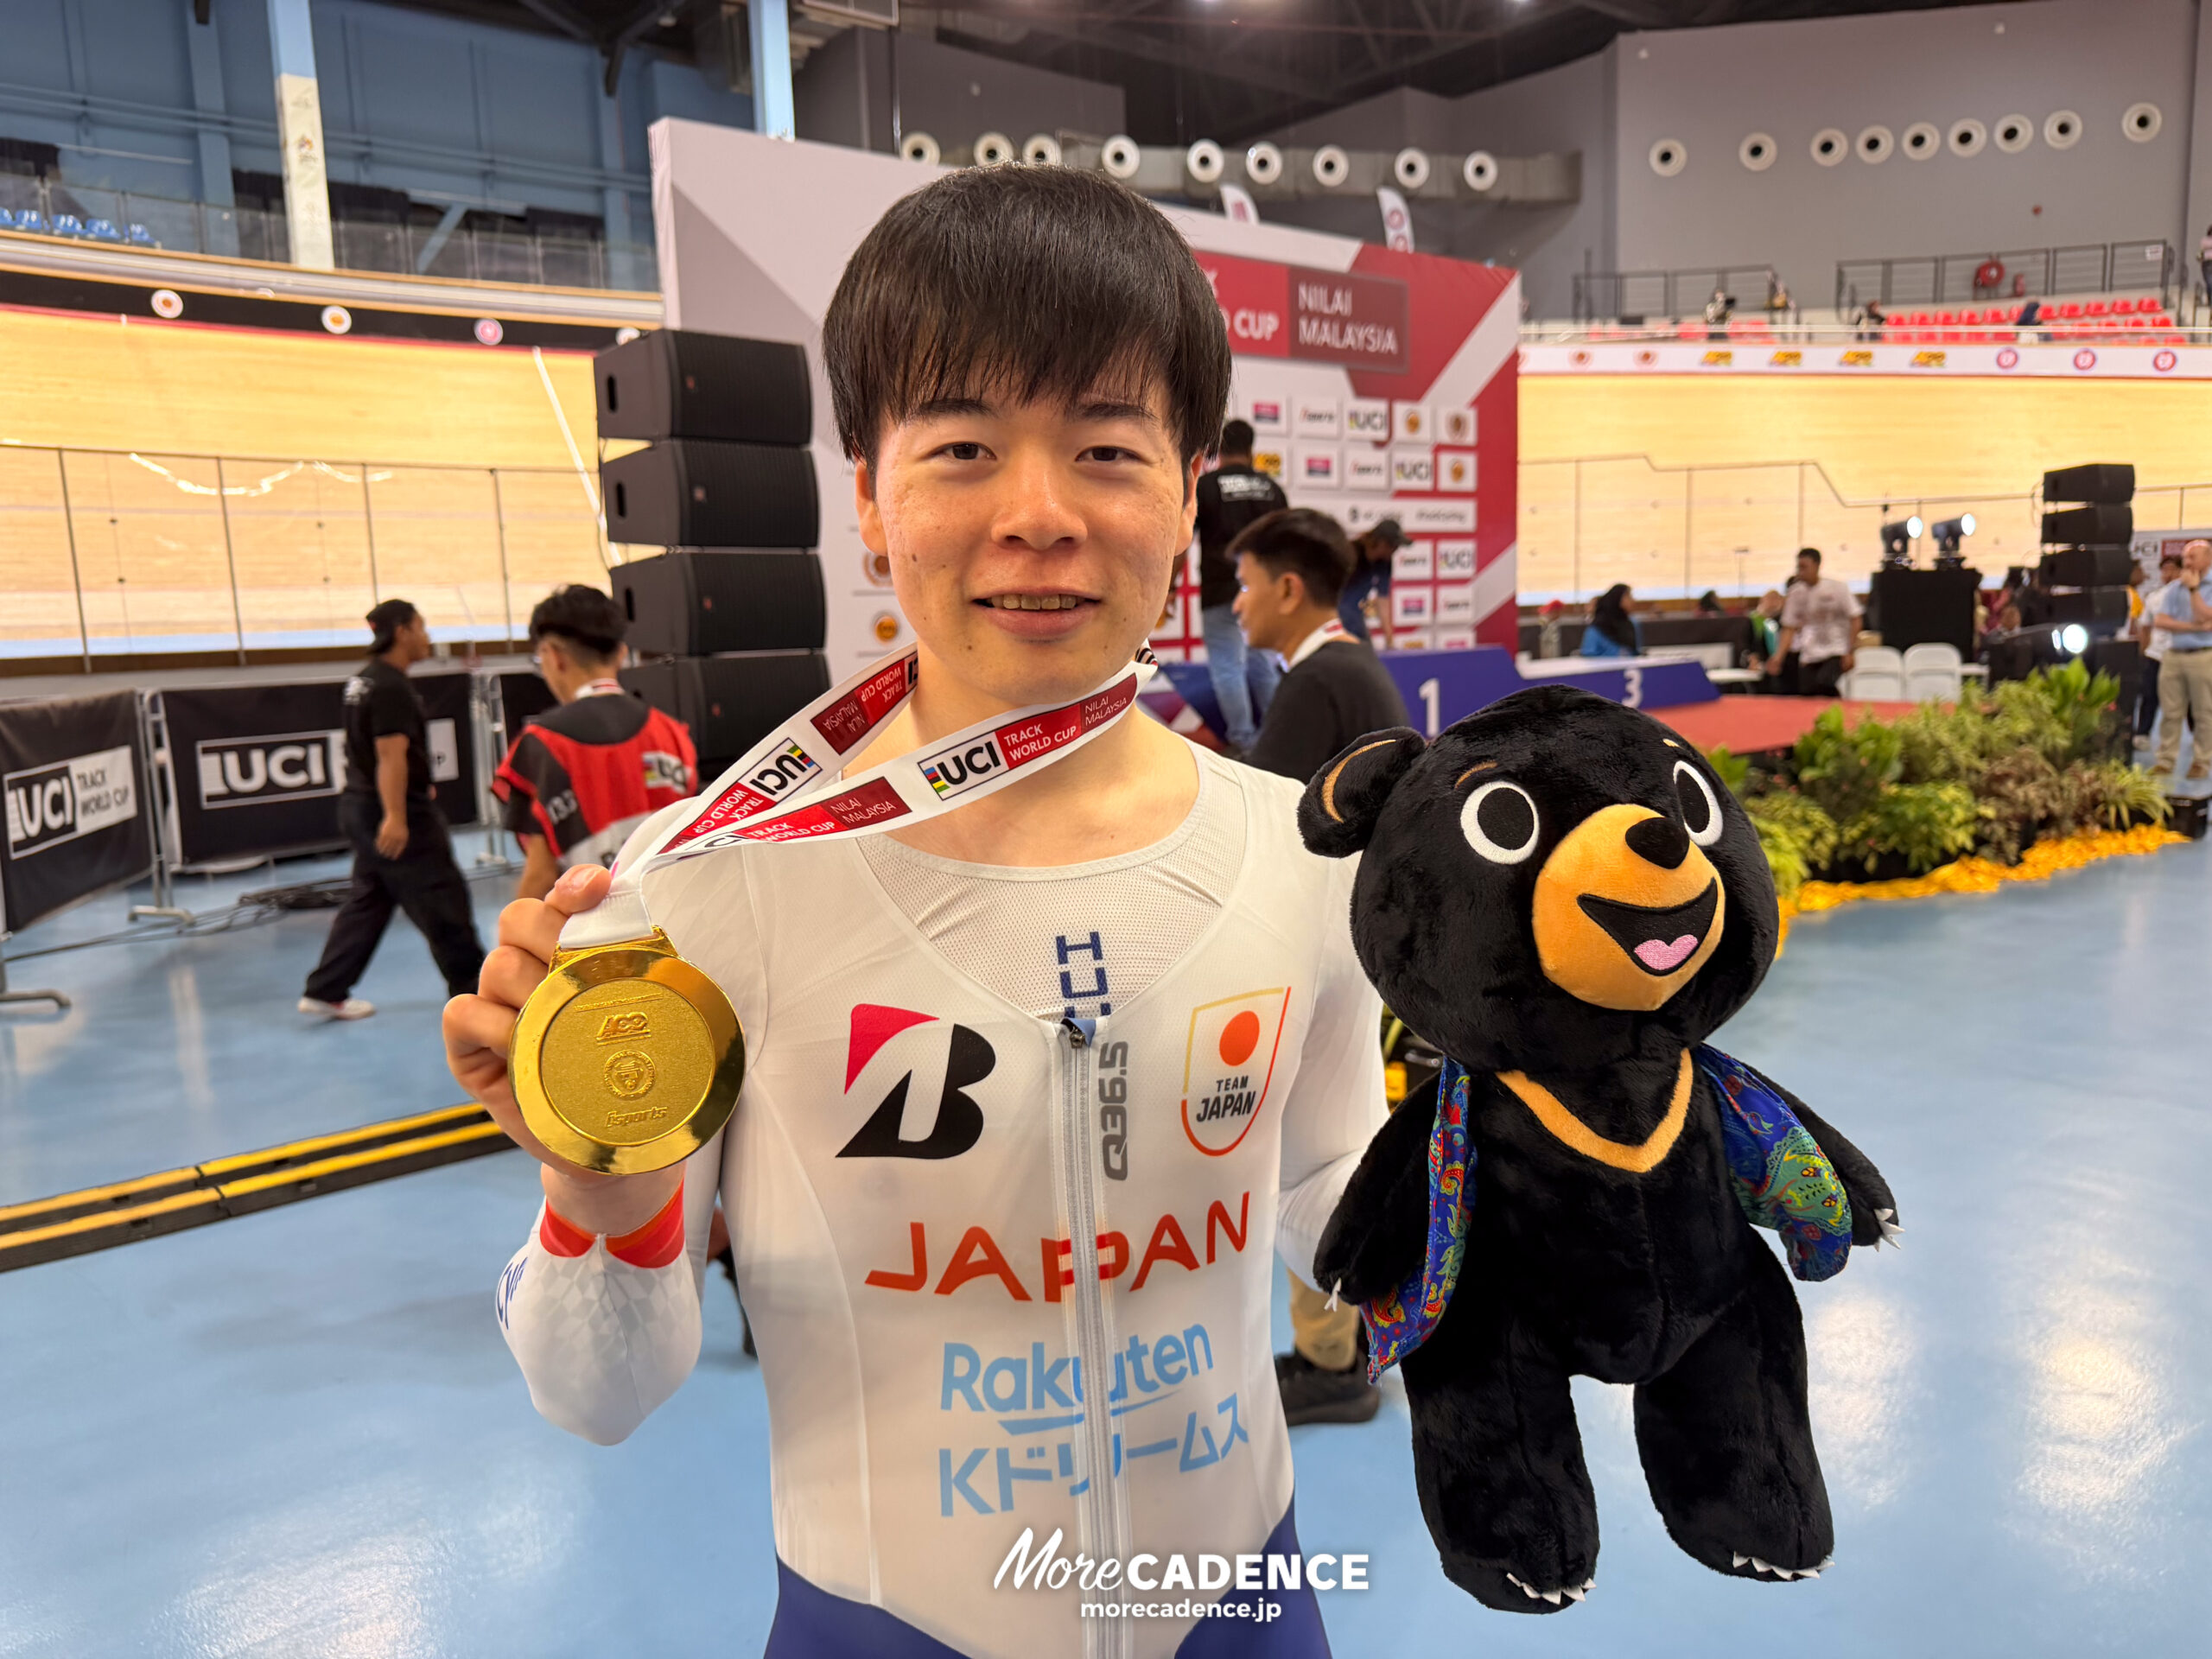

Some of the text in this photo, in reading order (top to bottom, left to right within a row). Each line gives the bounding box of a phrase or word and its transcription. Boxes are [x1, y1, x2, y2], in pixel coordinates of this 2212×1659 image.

[1298, 282, 1353, 317] NILAI
[1233, 308, 1280, 341] CUP
[1298, 316, 1398, 355] MALAYSIA
[861, 684, 875, 702] CUP
[875, 666, 902, 690] WORLD
[882, 680, 903, 702] TRACK
[1622, 668, 1643, 709] 3
[823, 700, 859, 731] MALAYSIA
[1085, 696, 1109, 715] NILAI
[1085, 697, 1127, 727] MALAYSIA
[1419, 677, 1440, 735] 1
[1004, 723, 1043, 747] TRACK
[1009, 725, 1077, 762] WORLD CUP
[77, 768, 106, 790] TRACK
[222, 743, 326, 793] UCI
[749, 753, 807, 796] UCI
[937, 741, 1001, 785] UCI
[16, 776, 73, 838] UCI
[81, 785, 129, 817] WORLD CUP
[693, 789, 749, 834] WORLD CUP
[728, 796, 764, 820] TRACK
[830, 798, 862, 813] NILAI
[842, 801, 896, 823] MALAYSIA
[748, 823, 795, 838] TRACK
[765, 822, 836, 842] WORLD CUP
[1216, 1075, 1249, 1092] TEAM
[1098, 1040, 1129, 1181] Q36.5
[1196, 1090, 1256, 1122] JAPAN
[865, 1191, 1250, 1302] JAPAN
[940, 1323, 1214, 1413] Rakuten
[938, 1393, 1249, 1517] Kドリームス
